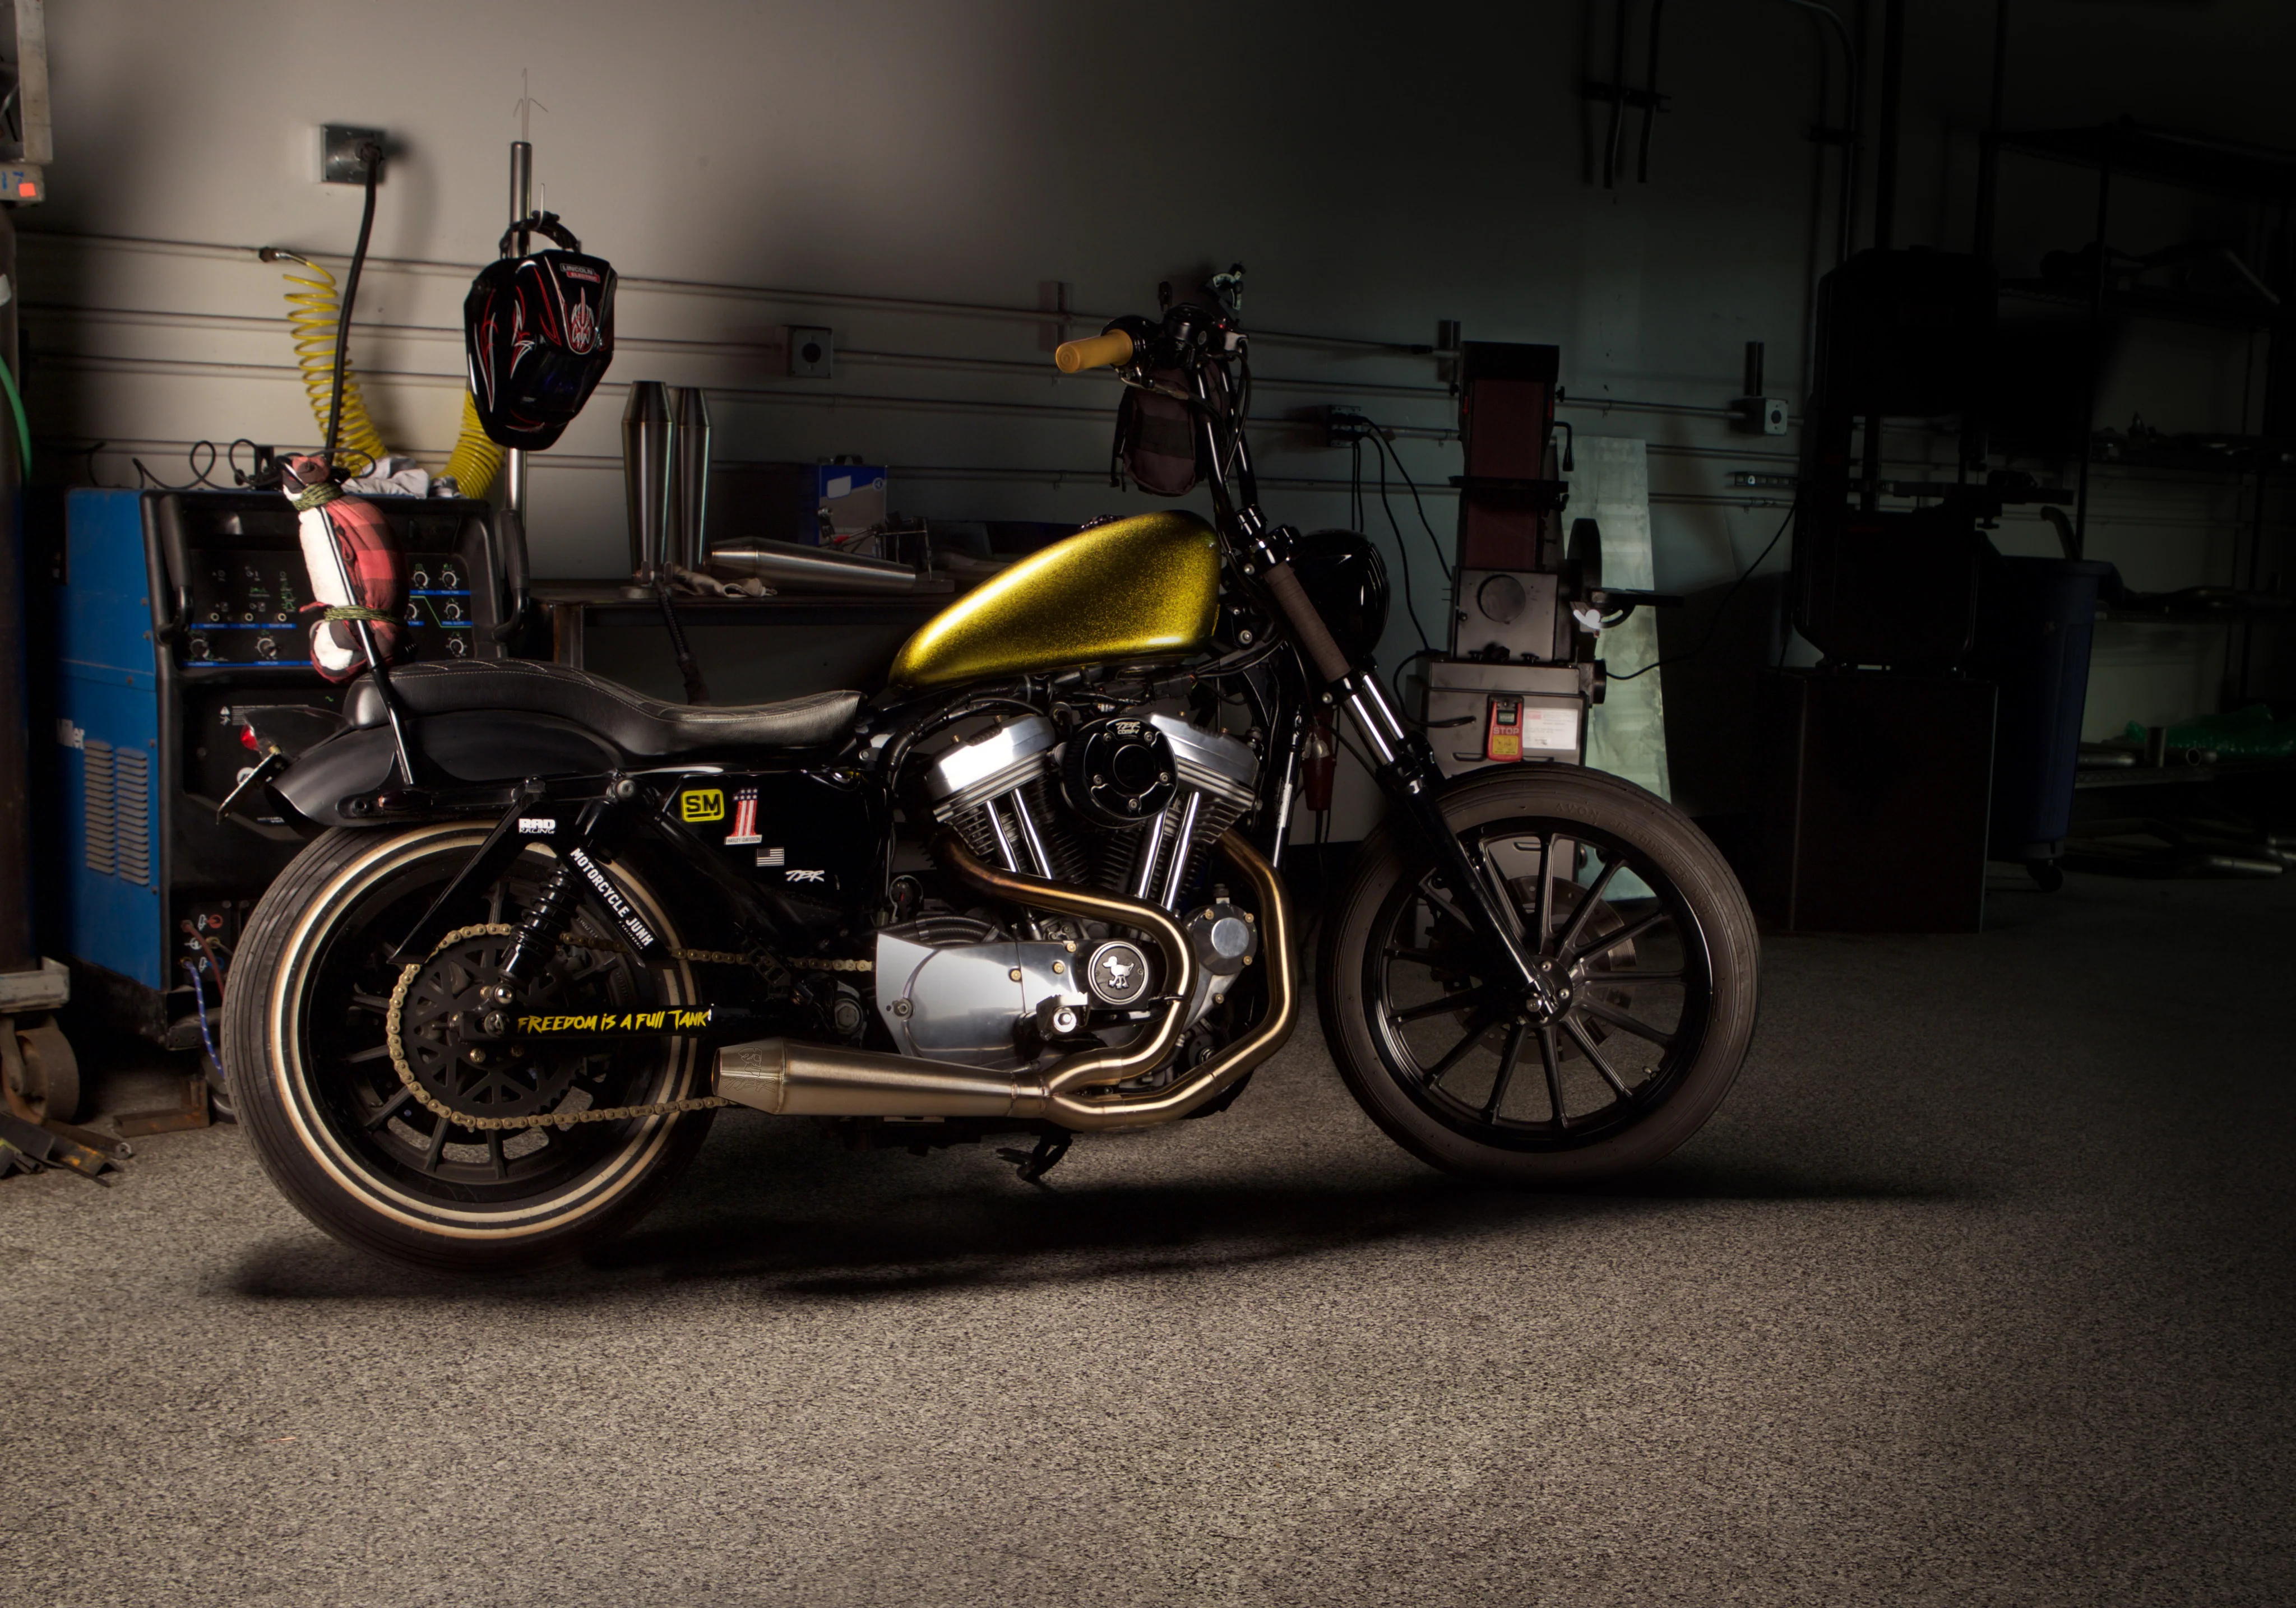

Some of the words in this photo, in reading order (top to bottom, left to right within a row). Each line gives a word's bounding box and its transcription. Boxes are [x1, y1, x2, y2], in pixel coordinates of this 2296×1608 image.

[1493, 726, 1520, 735] STOP
[1556, 801, 1601, 822] AVON
[519, 818, 556, 829] RAD
[570, 847, 630, 917] MOTORCYCLE
[517, 1015, 598, 1034] FREEDOM
[620, 1013, 632, 1030] A
[668, 1009, 709, 1030] TANK
